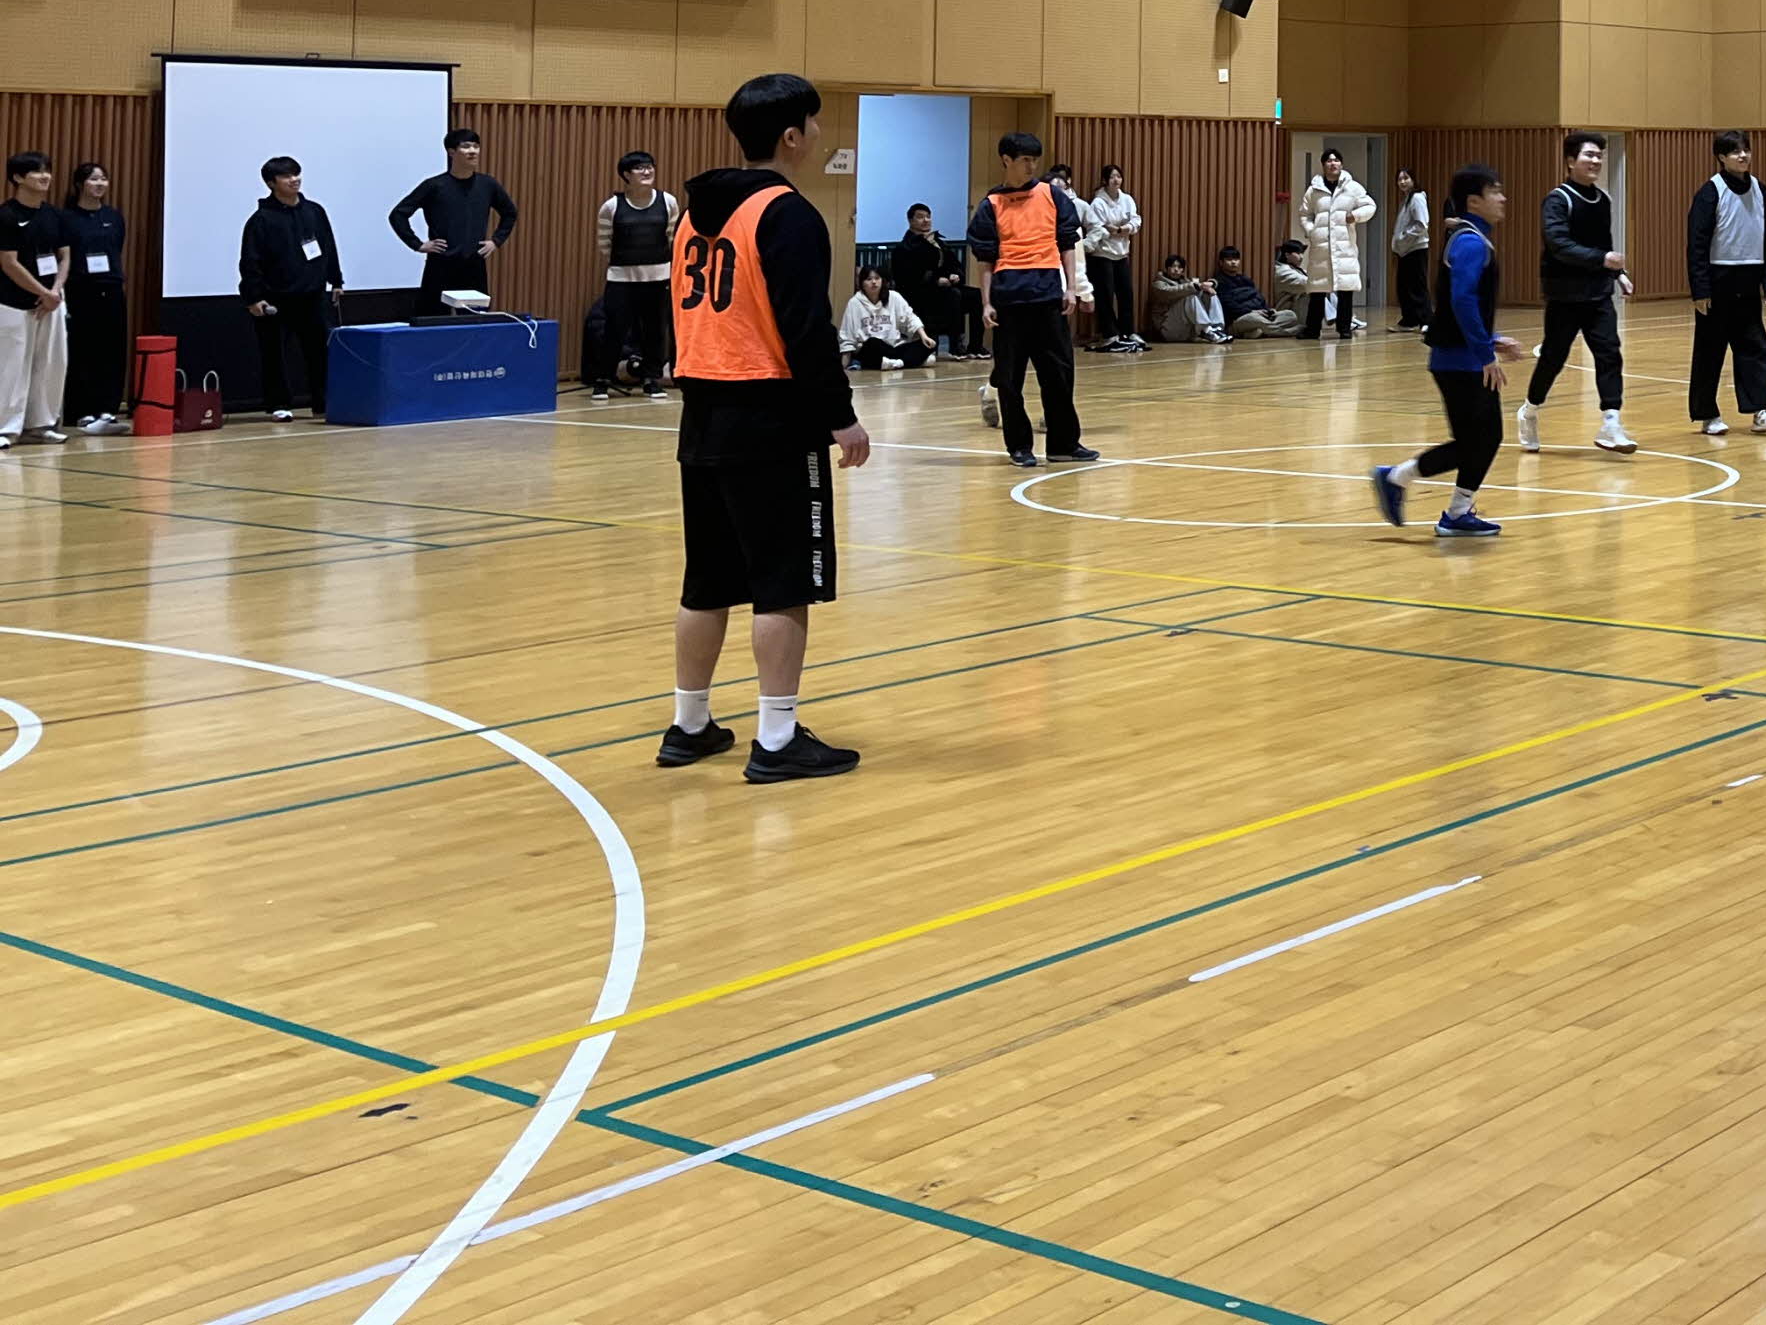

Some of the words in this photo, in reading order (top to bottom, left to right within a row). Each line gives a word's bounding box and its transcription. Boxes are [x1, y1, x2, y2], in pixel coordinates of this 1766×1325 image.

[682, 236, 736, 312] 30
[807, 452, 820, 488] FREEDOM
[811, 501, 822, 538] FREEDOM
[812, 550, 823, 587] FREEDOM
